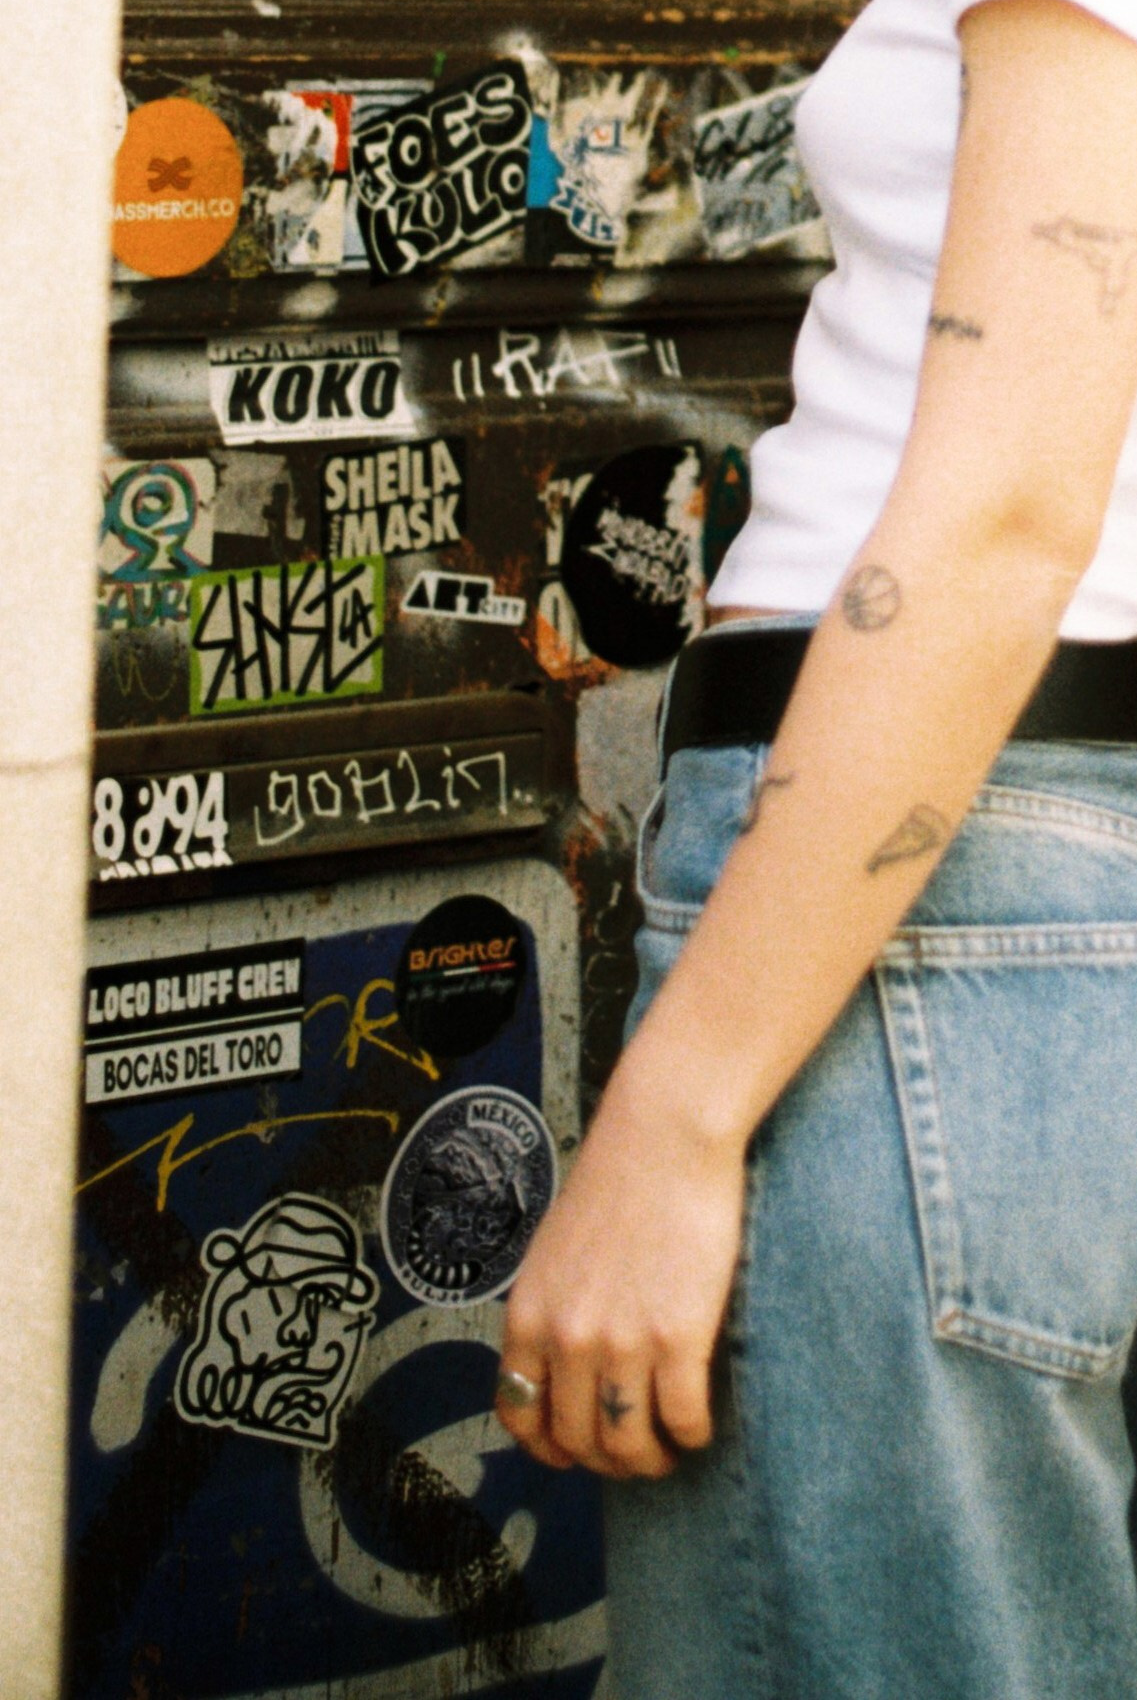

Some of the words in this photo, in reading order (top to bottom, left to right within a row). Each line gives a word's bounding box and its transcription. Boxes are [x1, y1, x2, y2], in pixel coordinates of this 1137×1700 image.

[350, 73, 532, 208] FOES
[227, 361, 400, 424] KOKO
[324, 440, 462, 511] SHEILA
[340, 494, 460, 559] MASK
[88, 972, 149, 1024] LOCO
[154, 959, 233, 1013] BLUFF
[238, 957, 299, 1000] CREW
[103, 1051, 178, 1093] BOCAS
[183, 1042, 219, 1080] DEL
[226, 1032, 283, 1071] TORO
